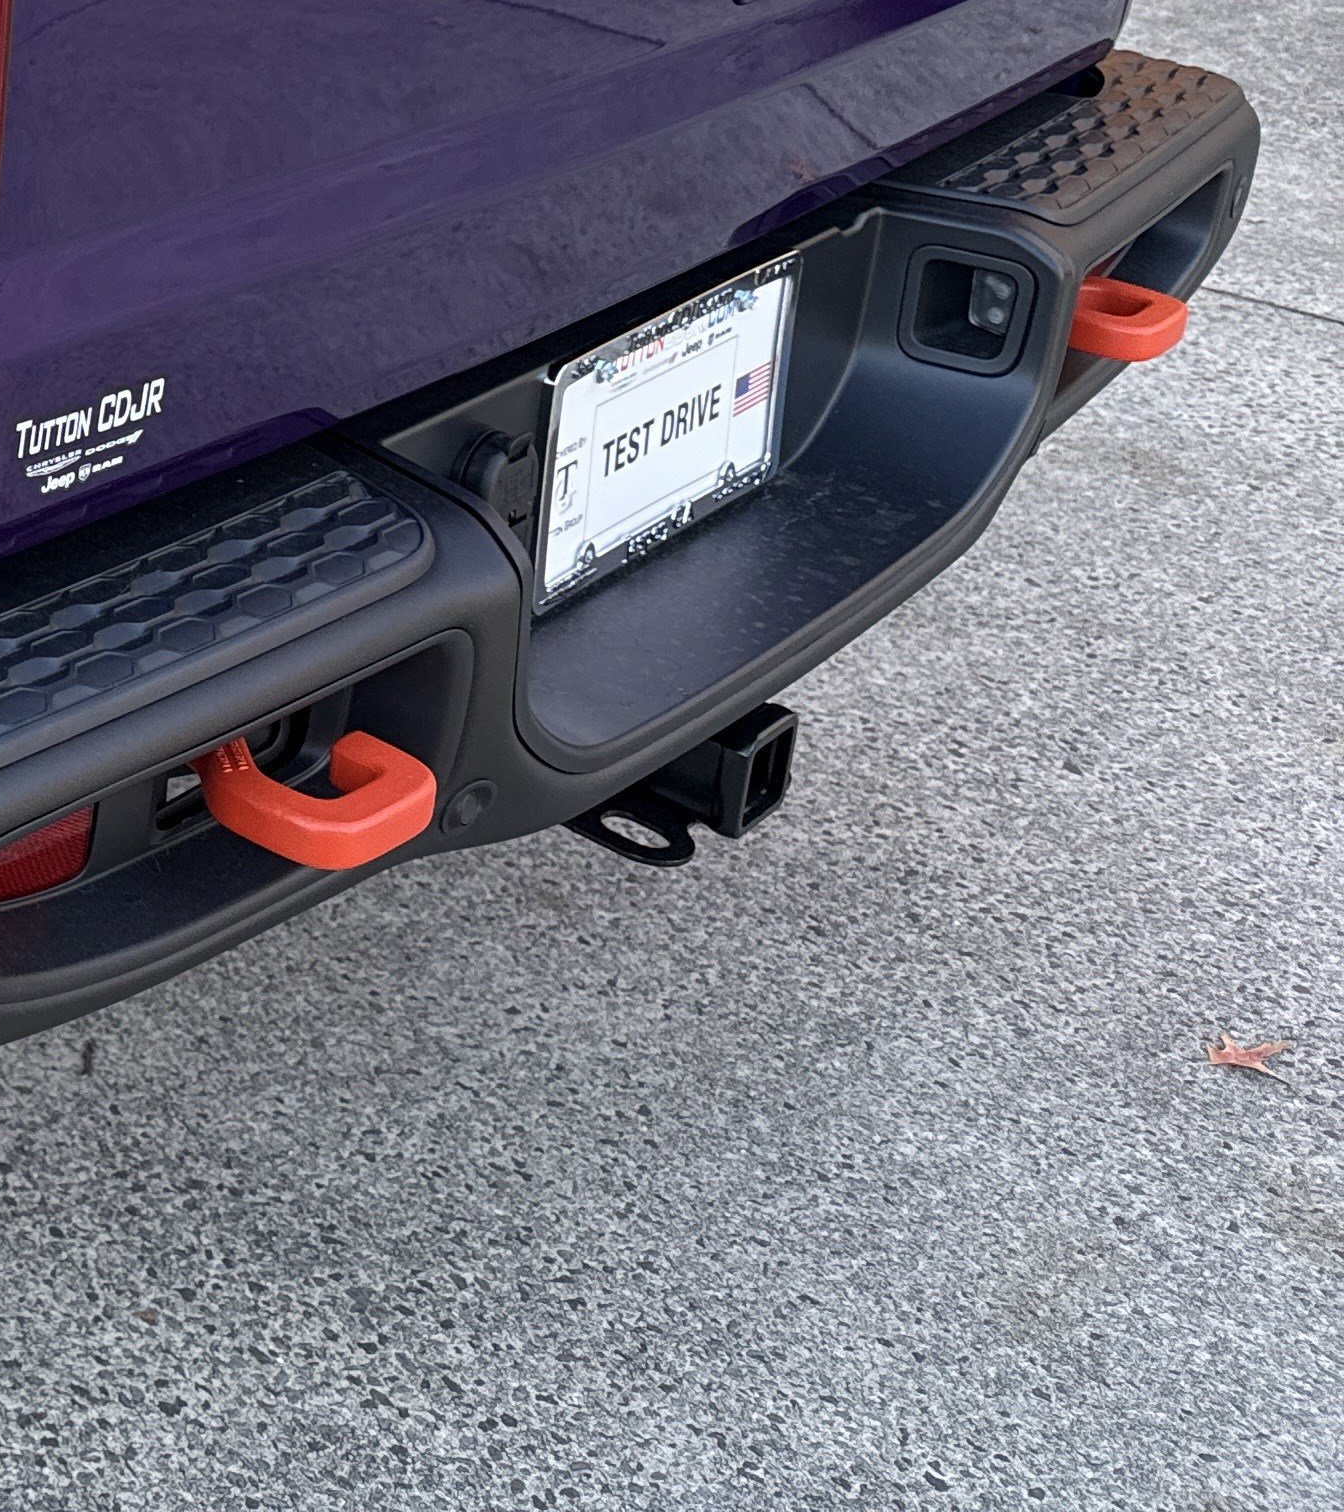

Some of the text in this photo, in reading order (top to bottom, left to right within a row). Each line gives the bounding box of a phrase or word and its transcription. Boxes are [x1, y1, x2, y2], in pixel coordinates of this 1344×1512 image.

[16, 377, 165, 459] TUTTON CDJR
[603, 383, 723, 478] TEST DRIVE
[25, 448, 83, 472] CHRYSLER
[40, 455, 124, 494] Jeep RAM
